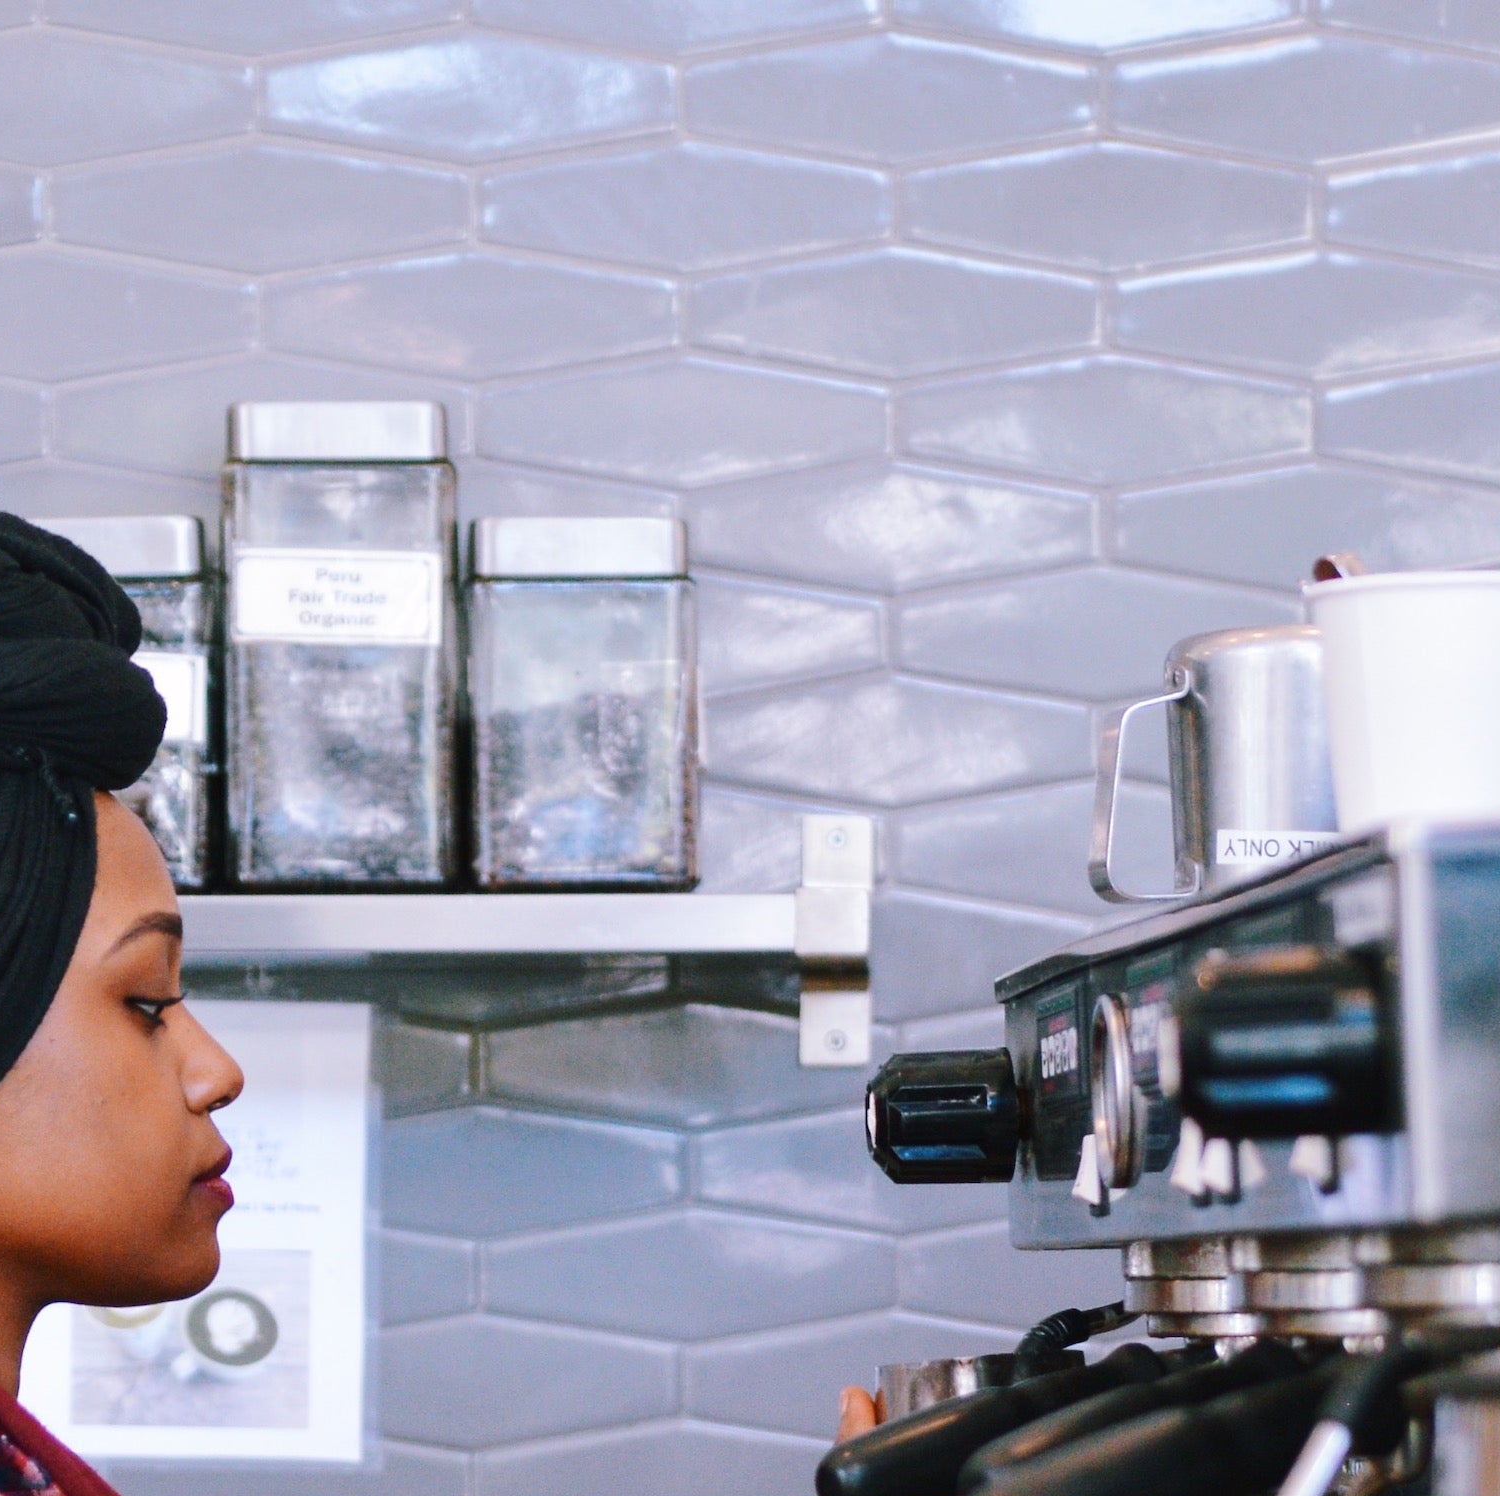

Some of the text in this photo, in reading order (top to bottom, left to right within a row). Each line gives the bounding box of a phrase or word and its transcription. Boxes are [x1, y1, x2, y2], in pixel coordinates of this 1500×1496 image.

[315, 567, 362, 583] Peru
[287, 588, 388, 605] Fair Trade
[299, 611, 377, 627] Organic
[1223, 838, 1280, 858] ONLY
